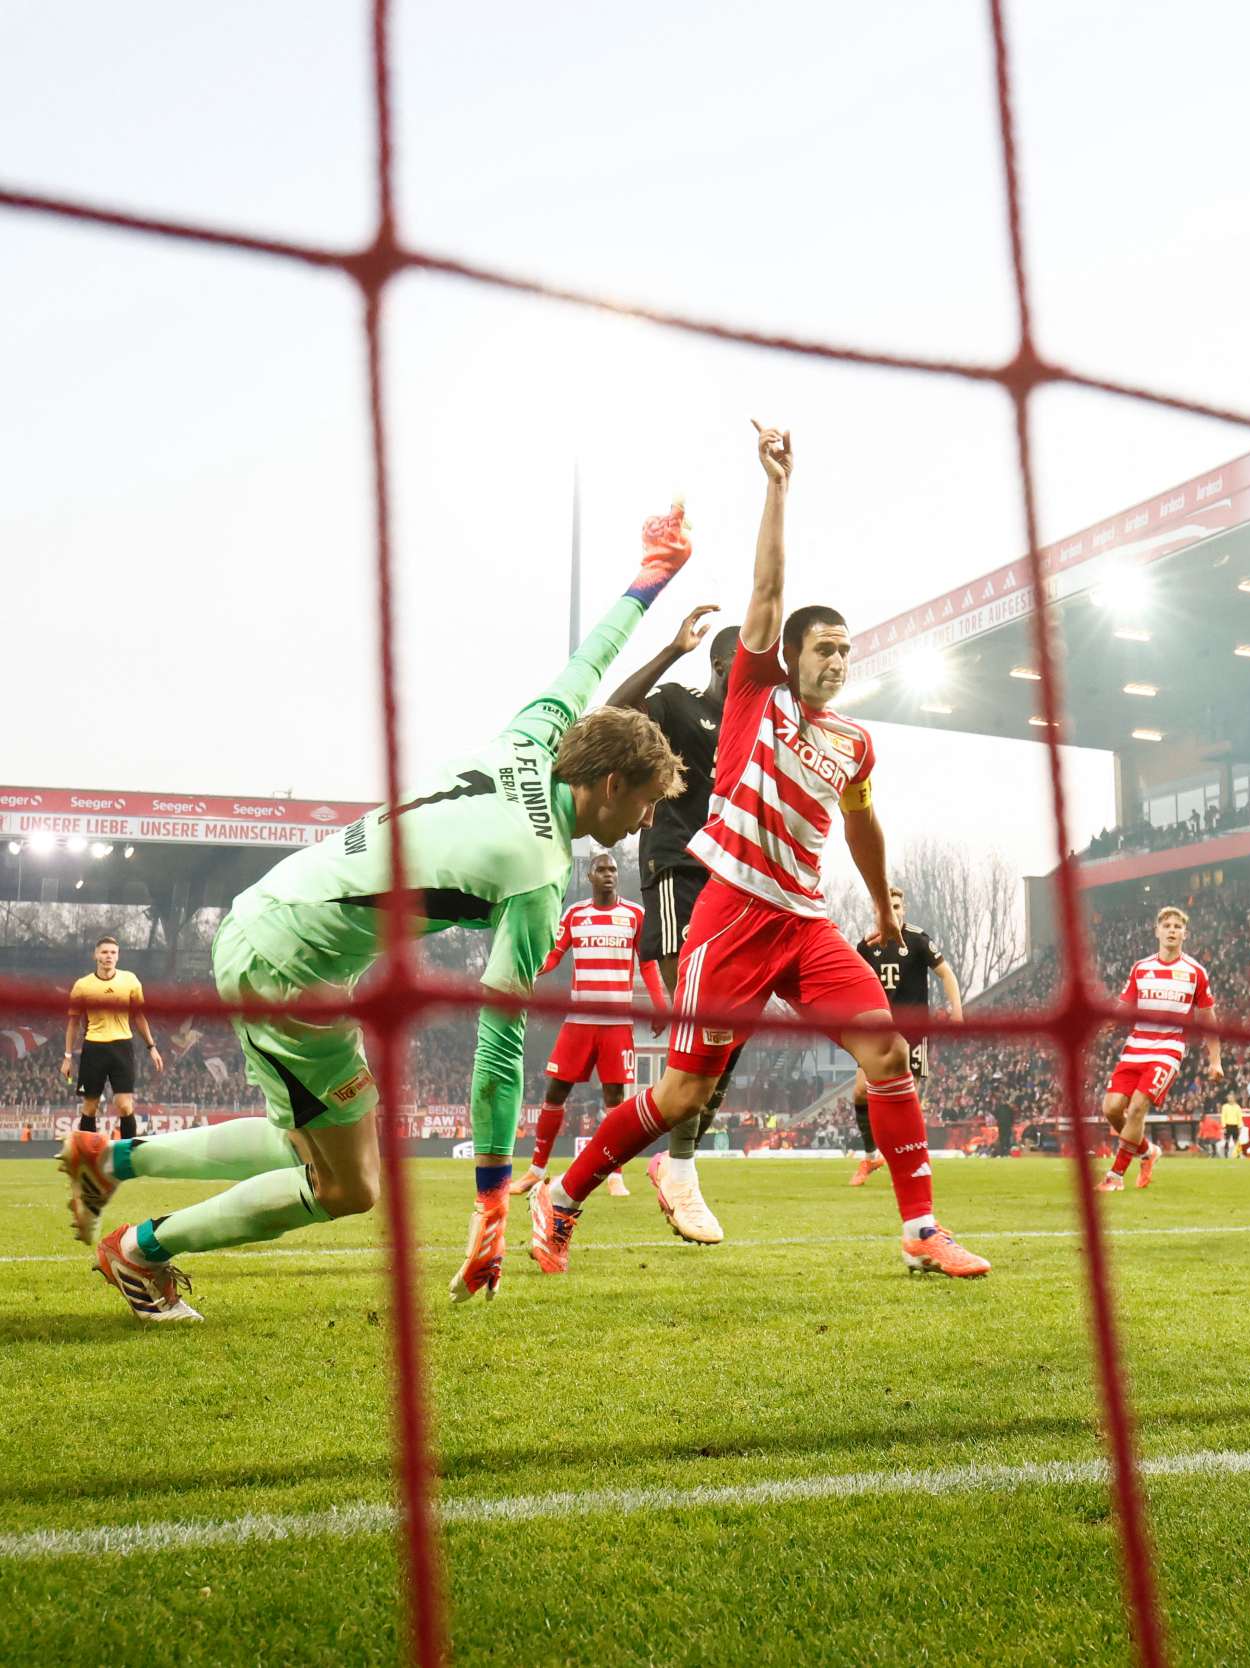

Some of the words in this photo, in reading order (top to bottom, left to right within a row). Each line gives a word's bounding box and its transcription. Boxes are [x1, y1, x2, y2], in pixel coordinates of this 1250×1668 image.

[516, 756, 539, 775] FC
[794, 740, 847, 793] raisin
[499, 767, 519, 803] BERLIN
[0, 796, 29, 807] eger
[70, 797, 113, 810] Seeger
[152, 800, 194, 814] Seeger
[233, 803, 273, 817] Seeger
[520, 781, 553, 840] UNION
[20, 816, 81, 833] UNSERE
[86, 818, 133, 835] LIEBE.
[140, 820, 199, 838] UNSERE
[204, 823, 308, 843] MANNSCHAFT.
[591, 936, 627, 947] raisin
[880, 963, 900, 990] T
[1150, 988, 1186, 1003] raisin
[621, 1049, 635, 1070] 10
[1152, 1065, 1168, 1089] 13
